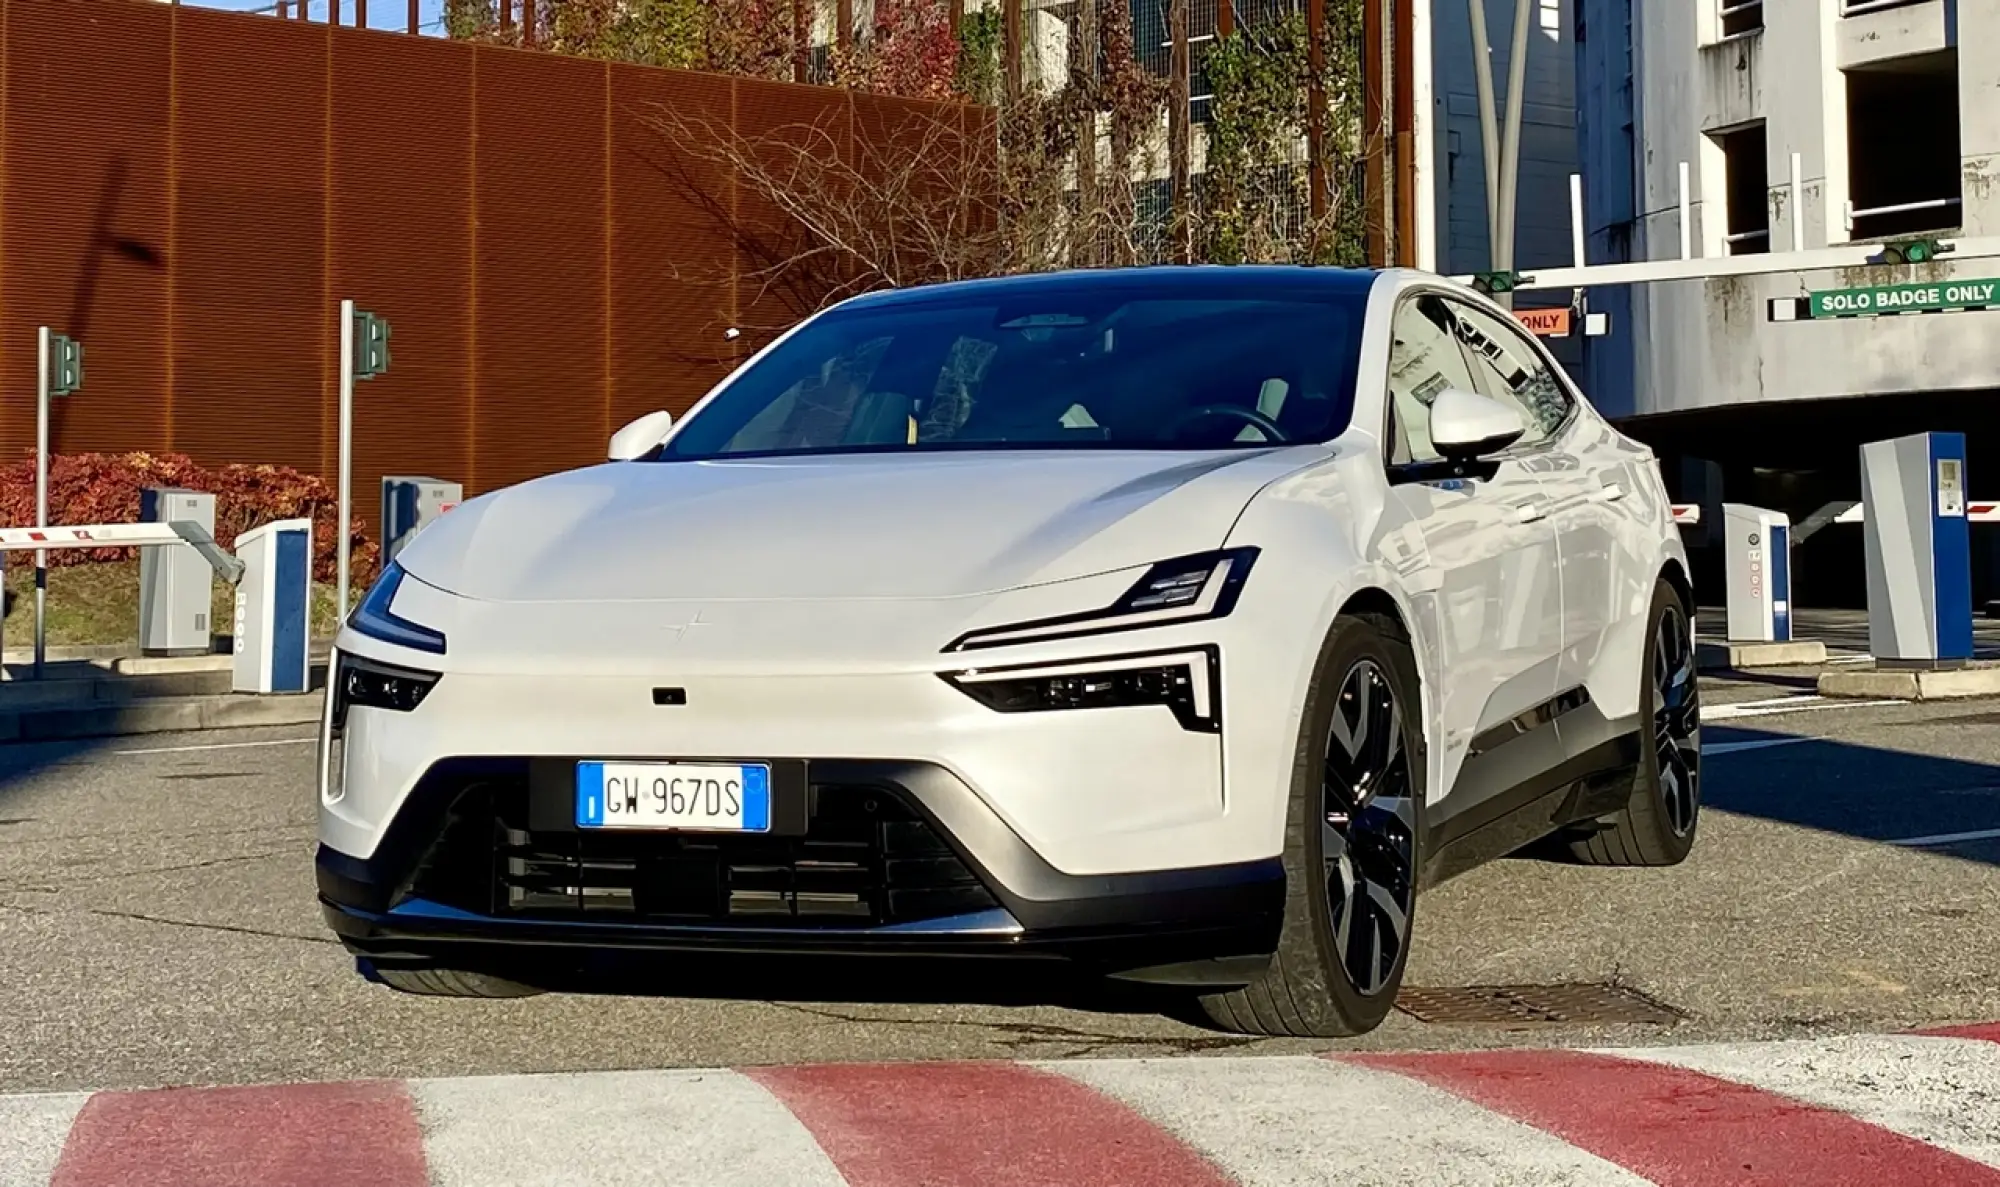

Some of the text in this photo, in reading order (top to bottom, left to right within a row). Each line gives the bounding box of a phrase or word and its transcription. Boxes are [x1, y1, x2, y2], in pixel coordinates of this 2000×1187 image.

[1821, 284, 1994, 311] SOLO BADGE ONLY
[1521, 315, 1560, 329] ONLY
[606, 777, 740, 816] GW 967DS
